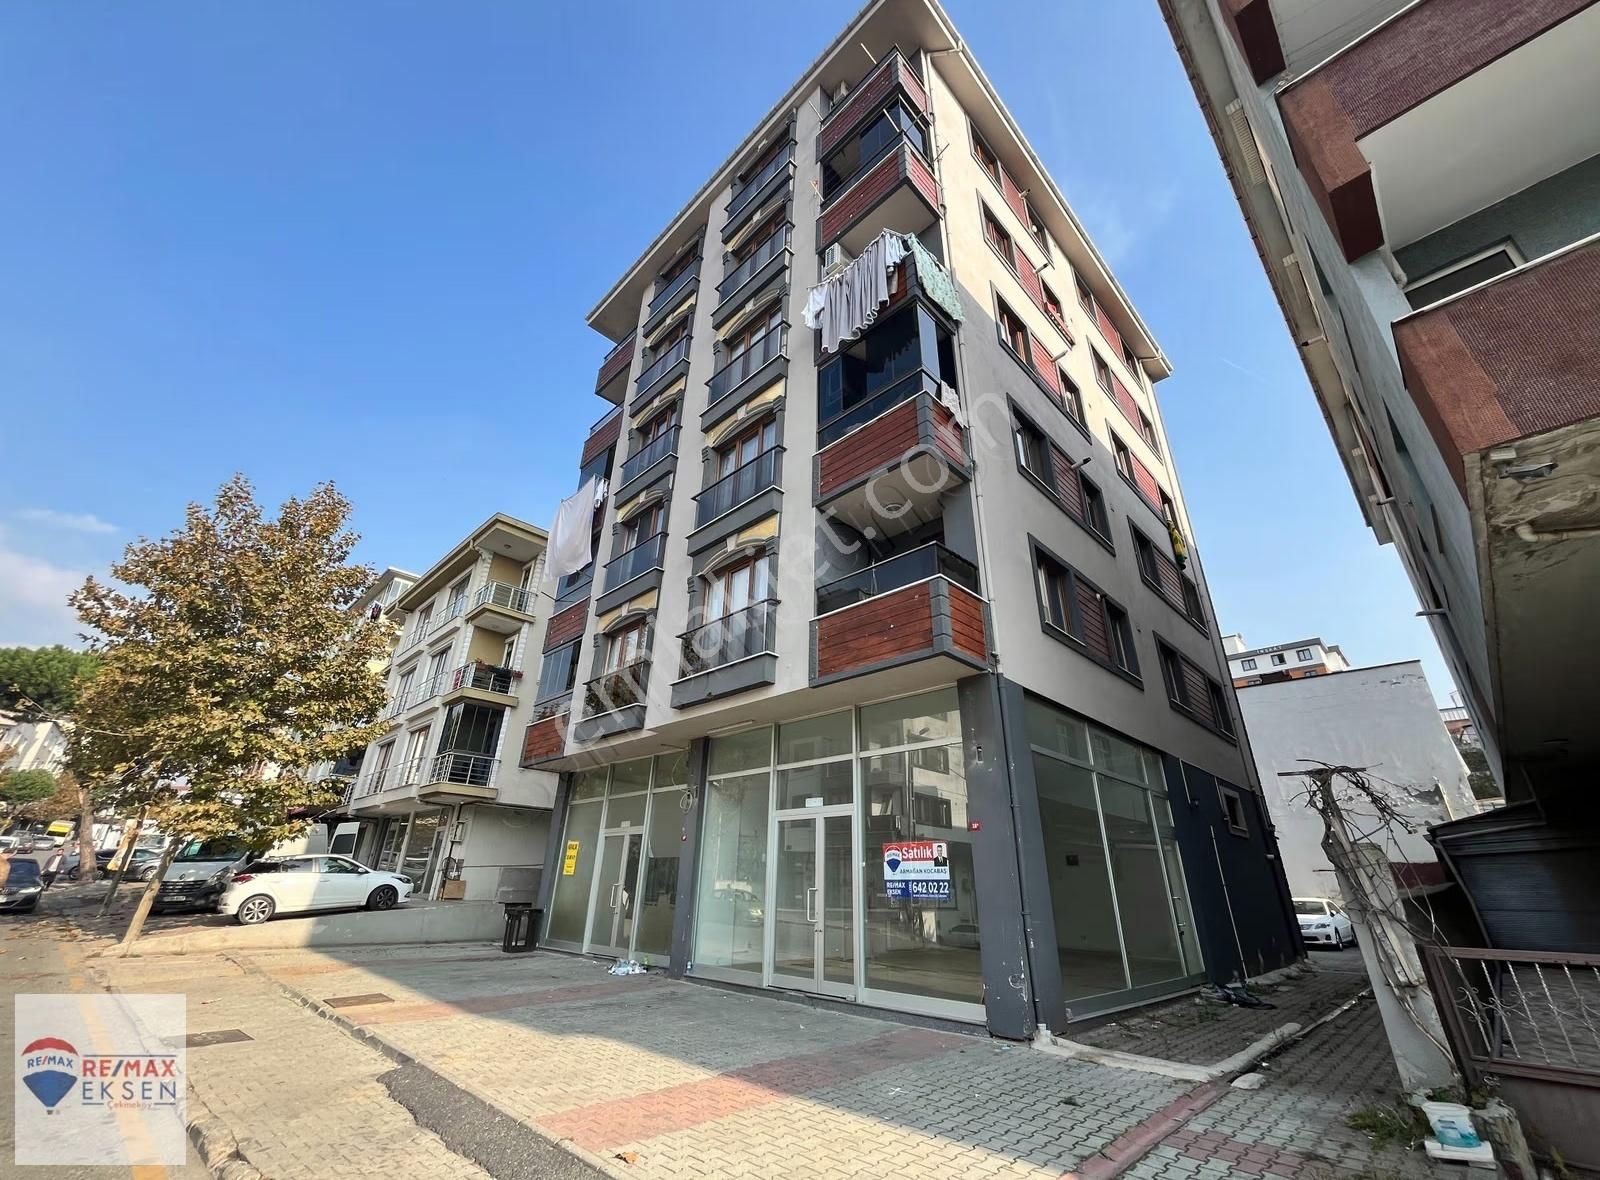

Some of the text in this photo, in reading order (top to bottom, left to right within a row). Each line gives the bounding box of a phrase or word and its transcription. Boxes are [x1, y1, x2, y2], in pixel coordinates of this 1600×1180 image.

[902, 846, 933, 859] Satılık
[886, 881, 906, 889] RE/MAX
[912, 882, 927, 893] 642
[928, 882, 938, 893] 02
[939, 882, 950, 894] 22
